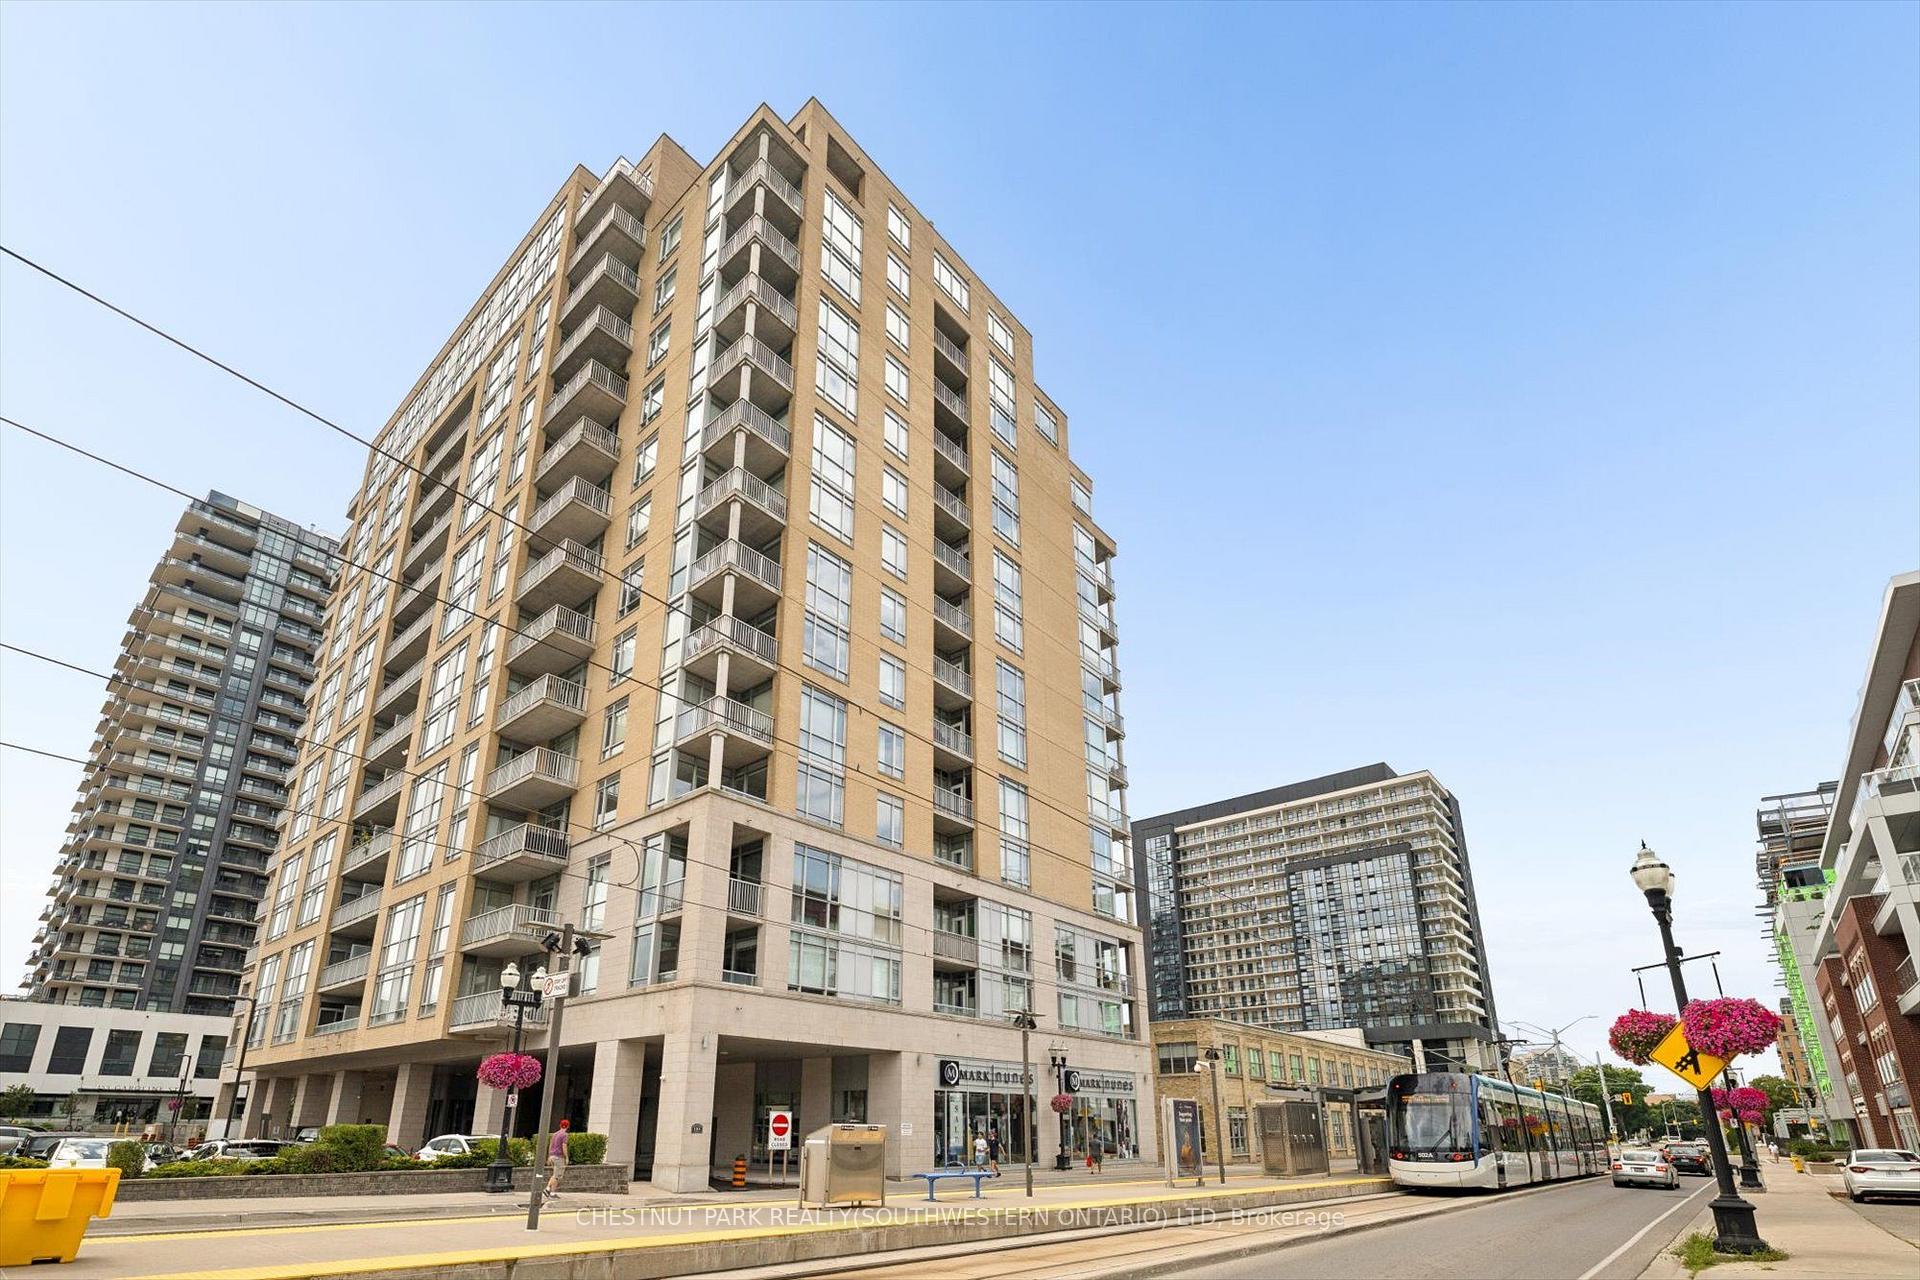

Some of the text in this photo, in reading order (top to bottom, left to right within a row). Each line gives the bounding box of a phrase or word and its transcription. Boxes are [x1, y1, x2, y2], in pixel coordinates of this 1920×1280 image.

[960, 1070, 990, 1082] MARK
[1080, 1079, 1134, 1091] MARK nunes
